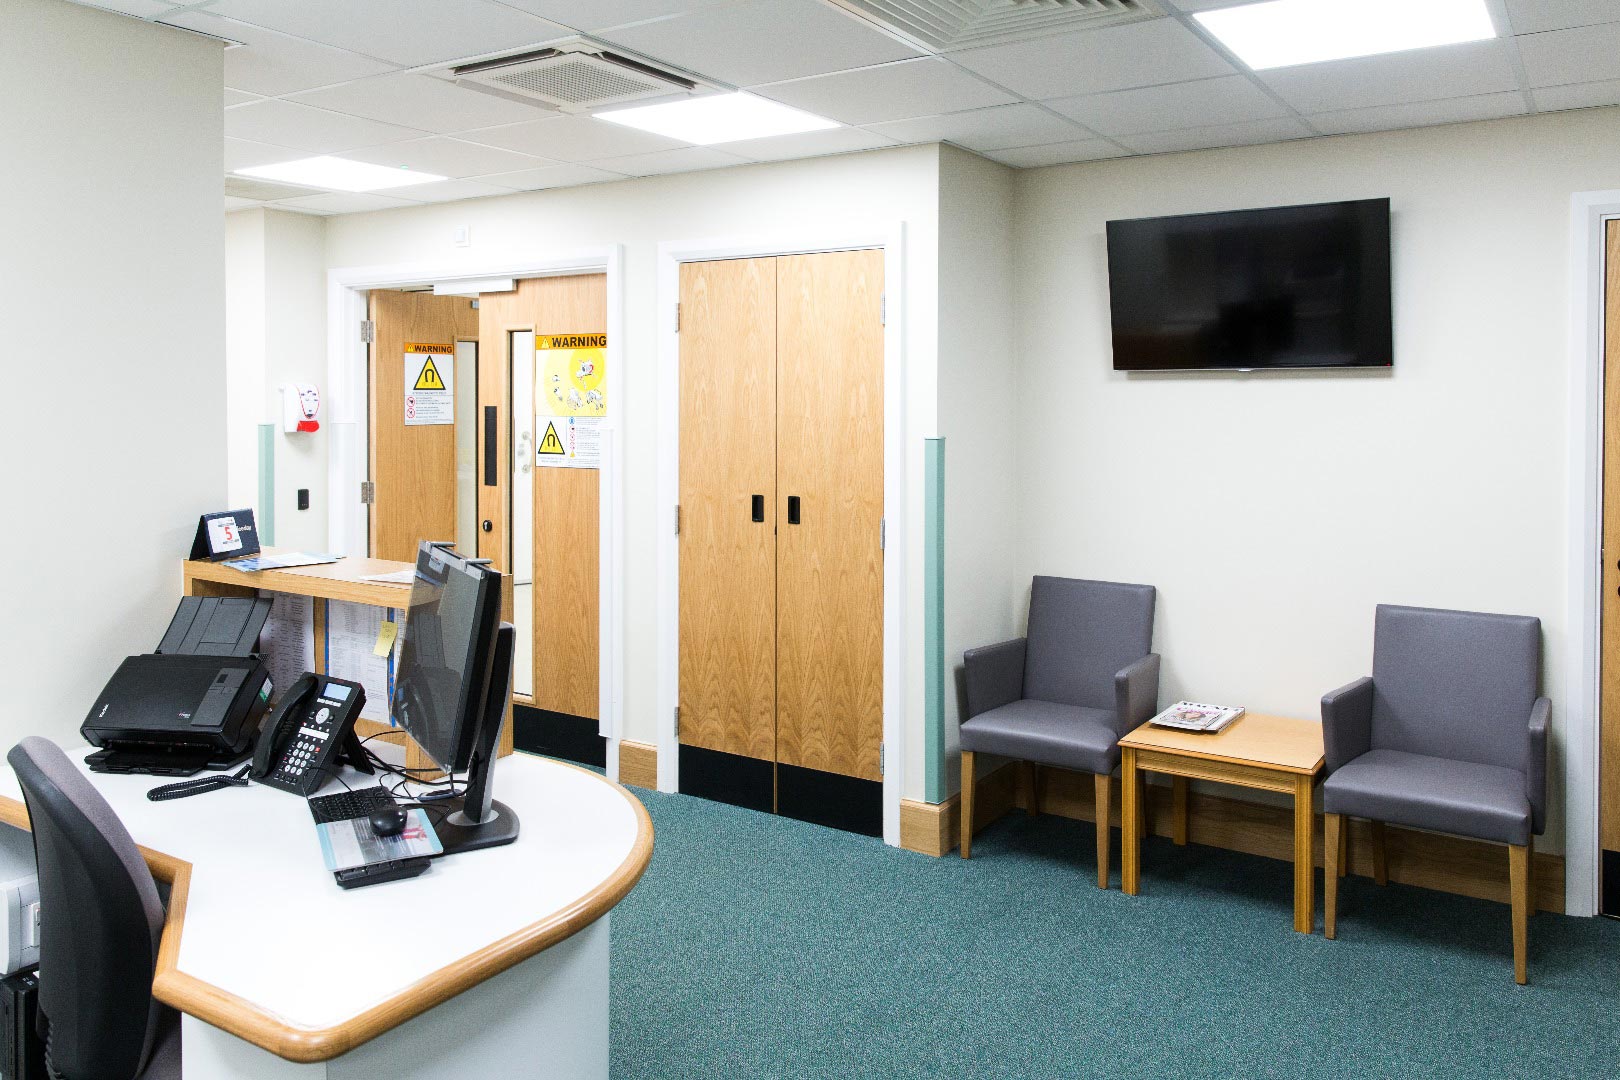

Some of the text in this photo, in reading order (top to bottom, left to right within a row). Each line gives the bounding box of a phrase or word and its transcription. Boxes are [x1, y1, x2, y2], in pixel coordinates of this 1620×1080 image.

[552, 335, 607, 348] WARNING
[414, 344, 453, 354] WARNING
[224, 526, 233, 541] 5
